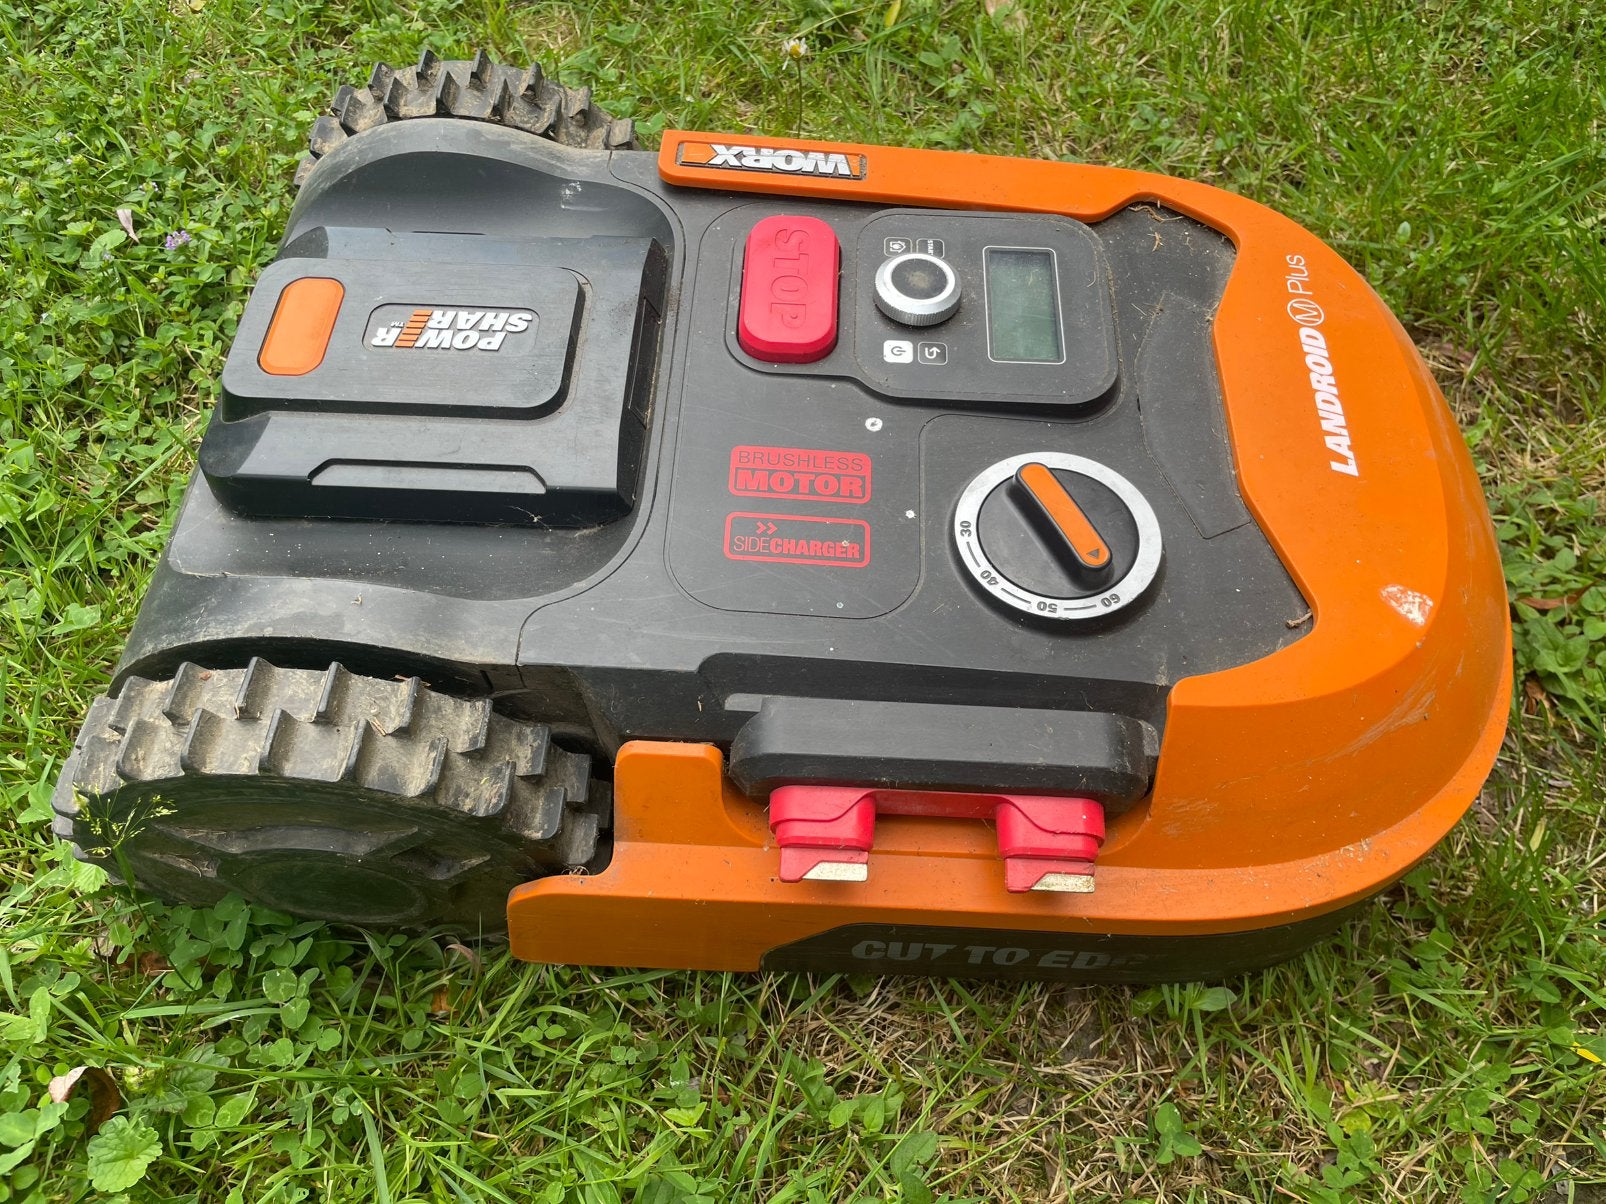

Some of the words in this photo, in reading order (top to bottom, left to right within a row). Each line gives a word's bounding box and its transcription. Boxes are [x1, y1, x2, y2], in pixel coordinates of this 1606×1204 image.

[708, 144, 850, 176] WORX
[770, 228, 809, 329] STOP
[1285, 254, 1313, 295] Plus
[1290, 301, 1323, 324] M
[371, 327, 507, 351] POWER
[1299, 327, 1359, 477] LANDROID
[738, 451, 864, 472] BRUSHLESS
[736, 469, 864, 497] MOTOR
[959, 520, 972, 538] 30
[980, 569, 1000, 587] 40
[1036, 601, 1058, 614] 50
[1101, 593, 1121, 608] 60
[851, 940, 957, 961] CUT
[964, 945, 1030, 966] TO
